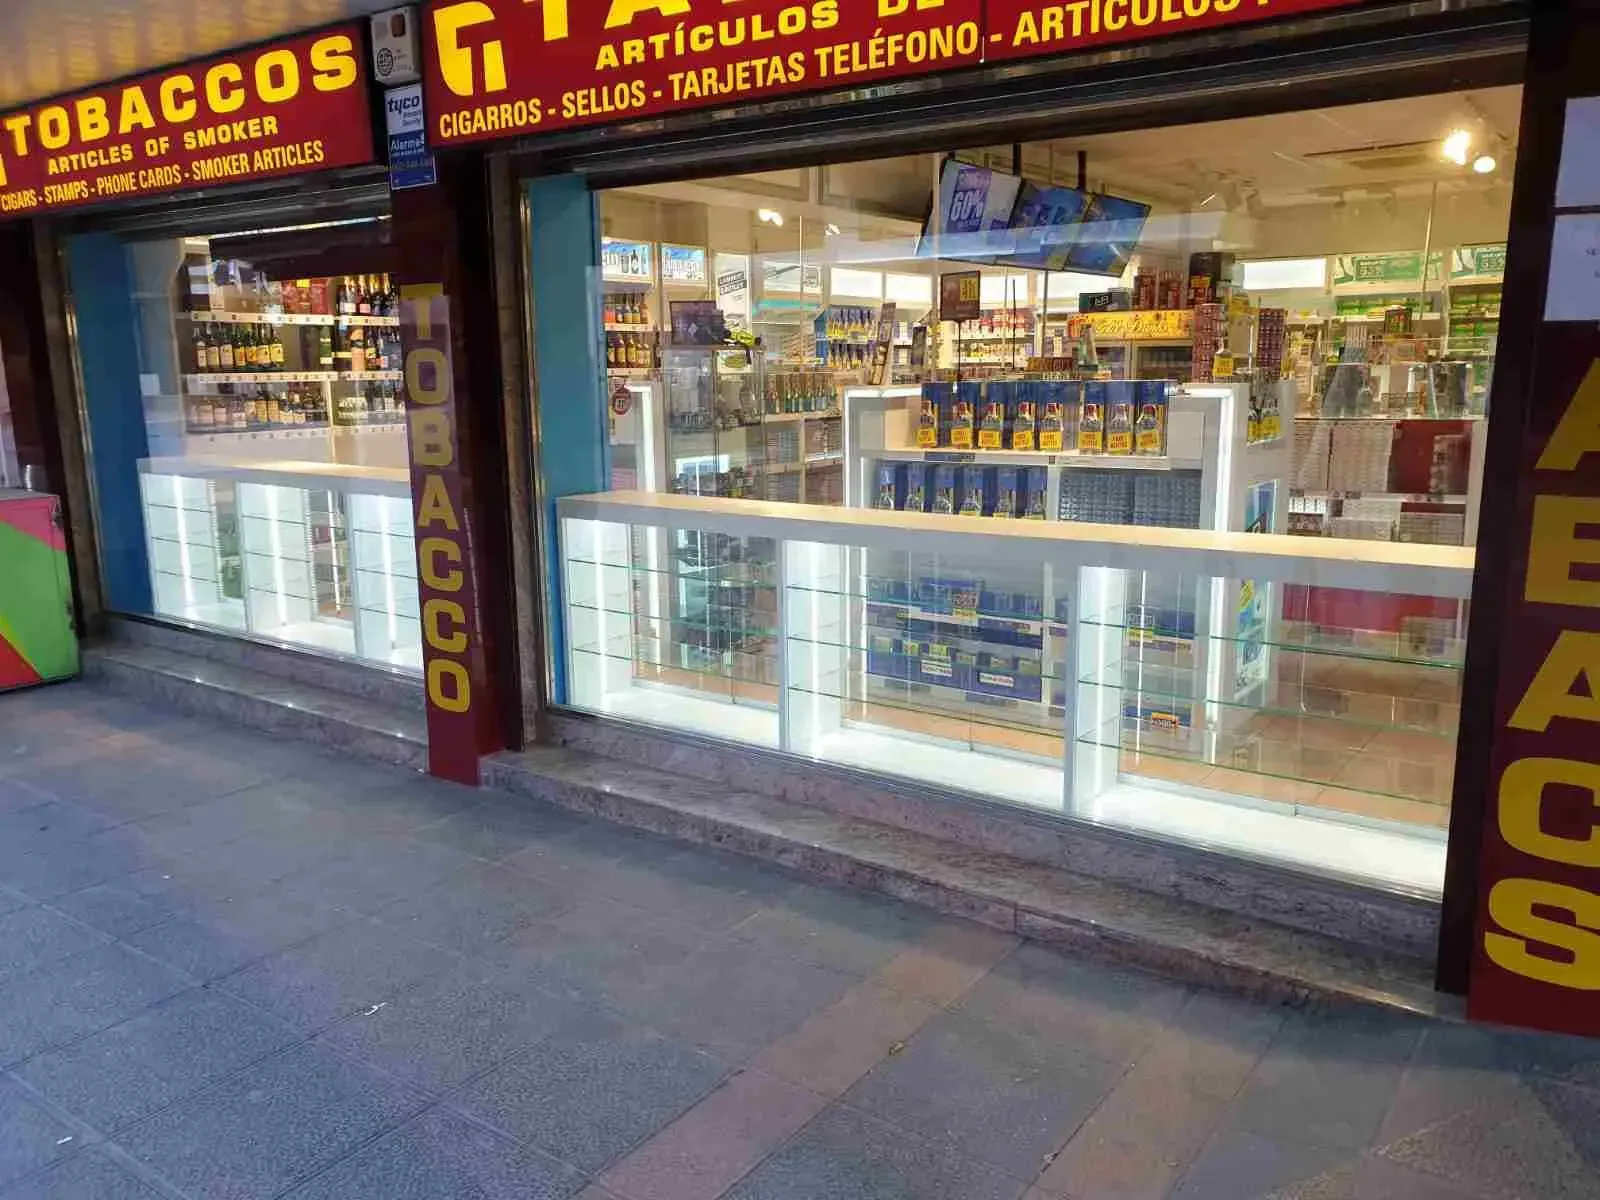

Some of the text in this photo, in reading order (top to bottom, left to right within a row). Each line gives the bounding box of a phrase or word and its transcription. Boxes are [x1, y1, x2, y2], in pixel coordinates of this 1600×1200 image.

[596, 0, 839, 71] ARTÍCULOS
[5, 36, 358, 157] TOBACCOS
[387, 95, 420, 113] tyco
[440, 98, 542, 138] CIGARROS
[562, 79, 646, 119] SELLOS
[668, 51, 806, 101] TARJETAS
[814, 21, 979, 78] TELÉFONO
[0, 189, 38, 211] CIGARS
[44, 180, 89, 204] STAMPS
[97, 172, 137, 196] PHONE
[139, 164, 182, 188] CARDS
[192, 153, 250, 181] SMOKER
[253, 140, 325, 173] ARTICLES
[47, 115, 279, 176] ARTICLES OF SMOKER
[400, 283, 471, 714] TOBACCO
